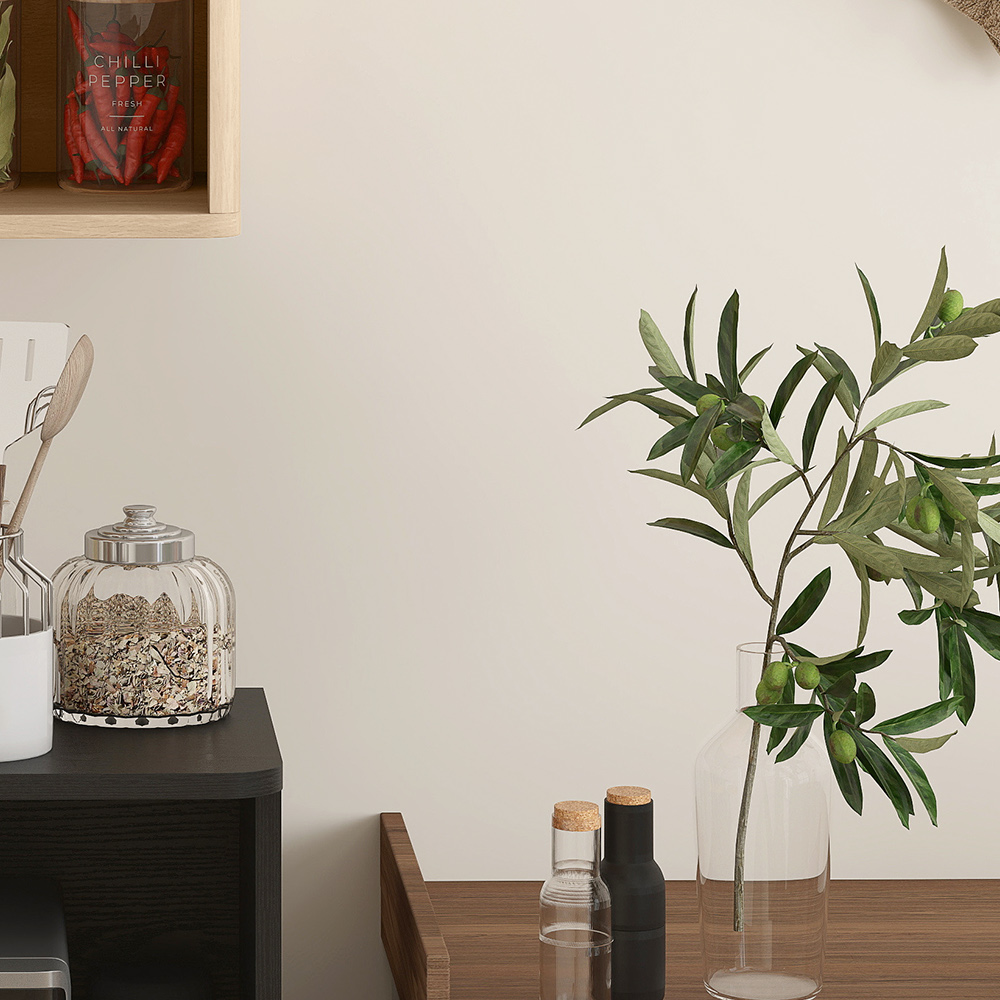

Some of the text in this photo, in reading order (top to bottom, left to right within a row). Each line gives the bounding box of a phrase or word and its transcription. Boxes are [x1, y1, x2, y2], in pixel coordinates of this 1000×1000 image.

[93, 55, 160, 68] CHILLI
[88, 74, 166, 88] PEPPER
[111, 100, 143, 108] FRESH
